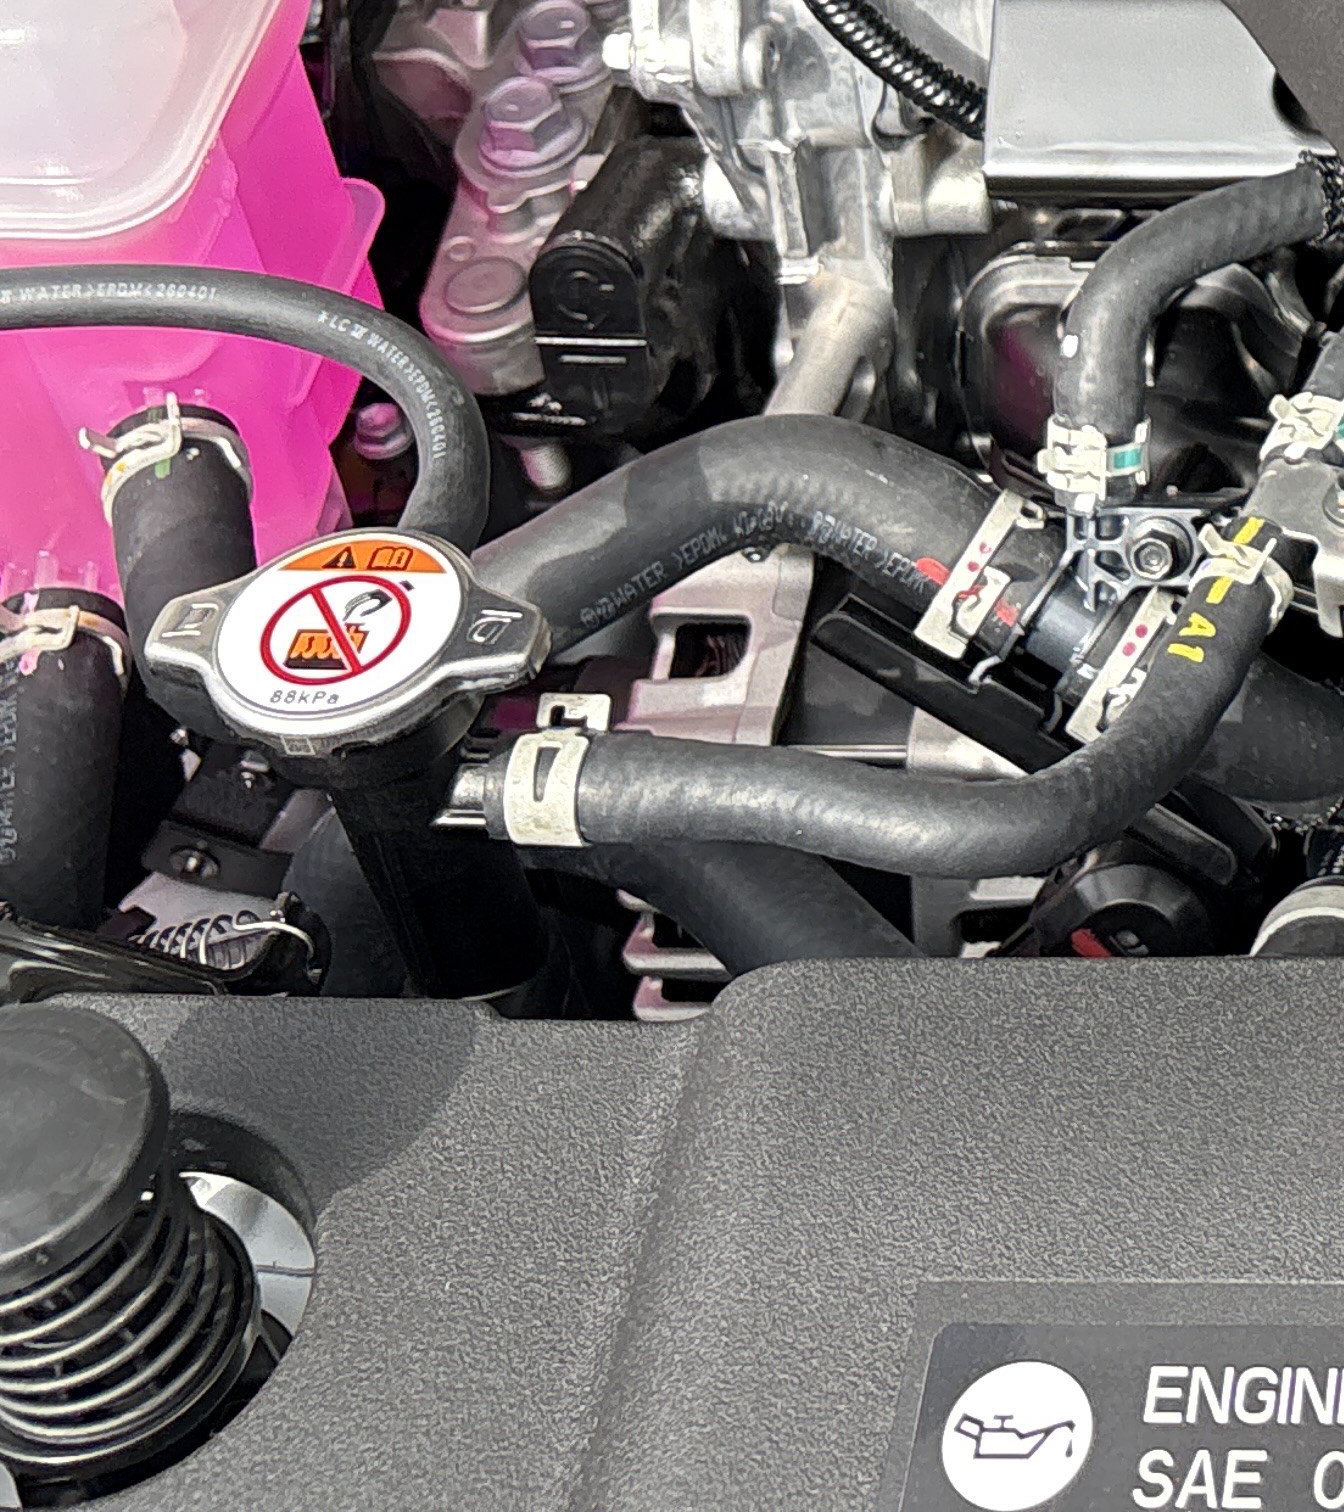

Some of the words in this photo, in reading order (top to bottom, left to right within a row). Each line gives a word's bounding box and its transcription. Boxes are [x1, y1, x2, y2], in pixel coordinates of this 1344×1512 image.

[17, 282, 82, 300] WATER
[270, 687, 340, 707] 88kPa
[1131, 1448, 1268, 1506] SAE
